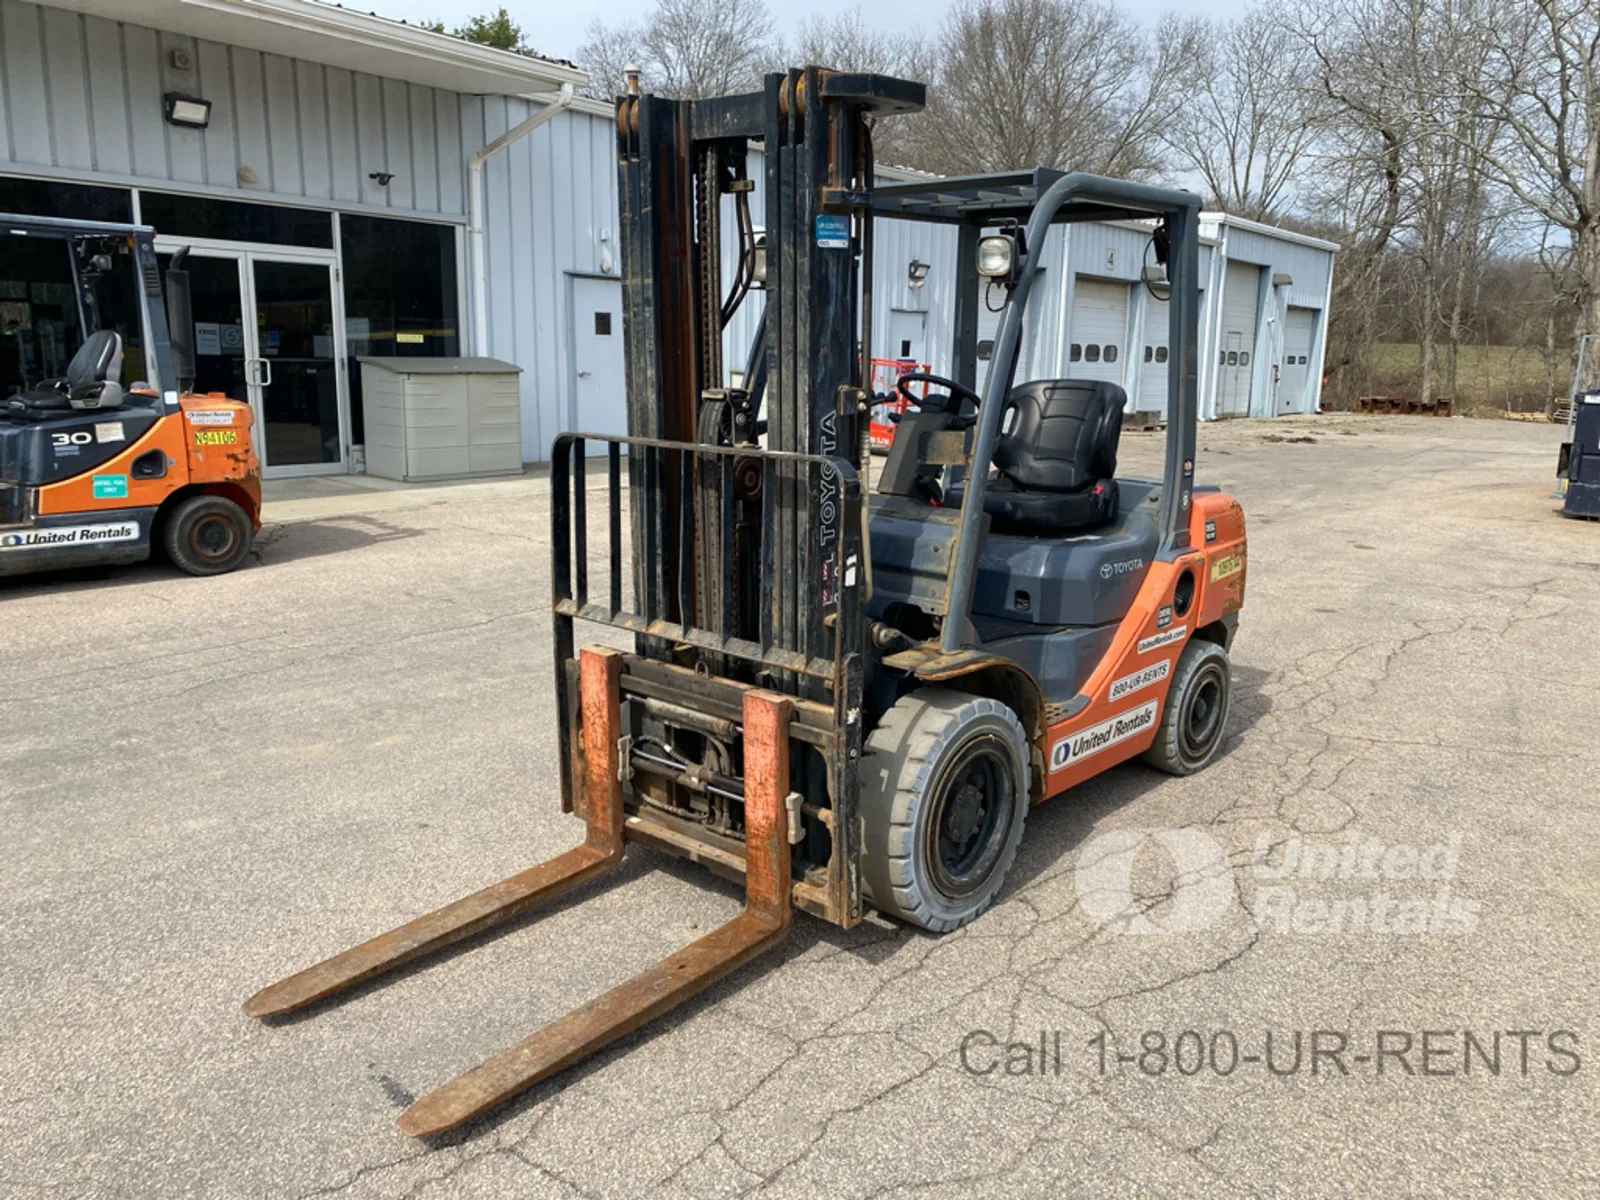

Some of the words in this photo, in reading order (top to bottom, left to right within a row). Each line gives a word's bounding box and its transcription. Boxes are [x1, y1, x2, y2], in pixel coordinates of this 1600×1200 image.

[1107, 252, 1114, 266] 4
[51, 432, 92, 446] 30
[195, 431, 236, 445] N94106
[820, 410, 837, 546] TOYOTA
[26, 530, 76, 545] United
[79, 526, 132, 541] Rentals
[1112, 558, 1144, 575] TOYOTA
[1112, 663, 1168, 697] 800-UR-RENTS
[1072, 724, 1113, 757] United
[1113, 708, 1153, 738] Rentals
